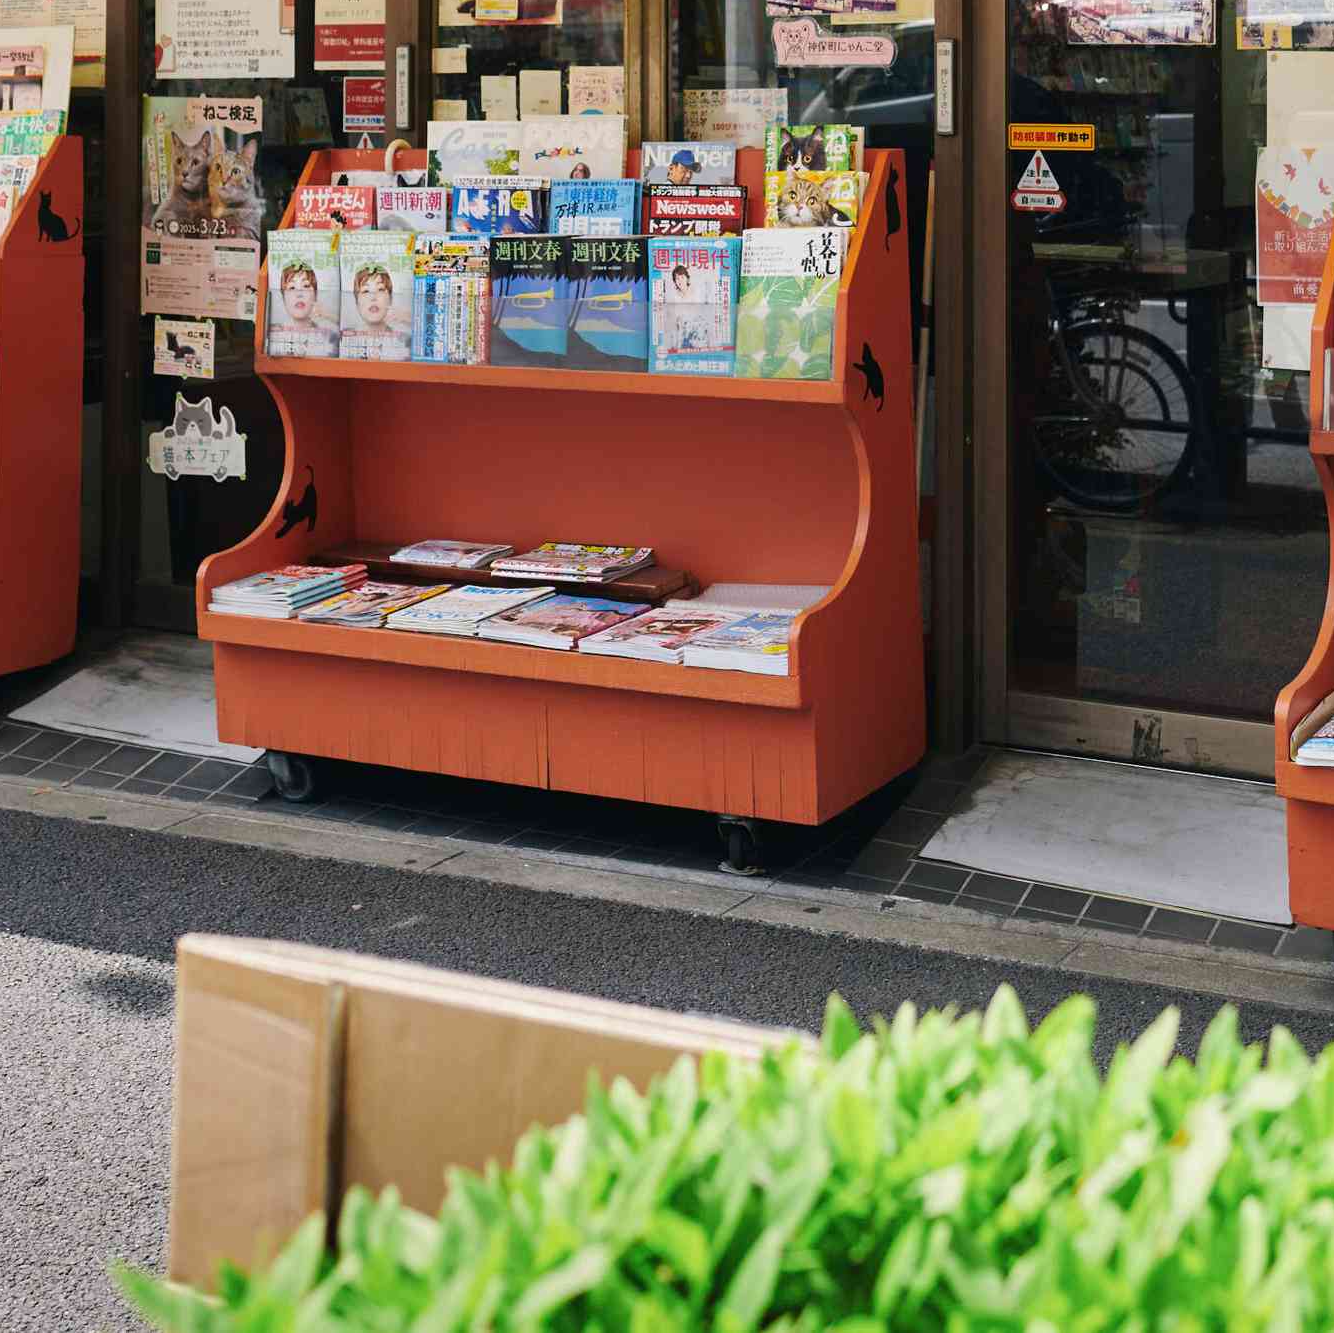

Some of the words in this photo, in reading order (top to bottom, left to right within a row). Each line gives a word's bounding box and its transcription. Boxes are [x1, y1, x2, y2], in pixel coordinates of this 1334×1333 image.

[807, 39, 884, 54] 神保町にゃんこ堂
[203, 104, 258, 125] ねこ検定
[1012, 132, 1089, 143] 防犯装置作動中
[1027, 169, 1050, 178] 注意
[300, 189, 365, 212] サザエさん
[379, 191, 443, 212] 週刊新潮
[655, 198, 737, 217] Newsweek
[494, 240, 562, 263] 週刊文春
[571, 241, 641, 263] 週刊文春
[653, 249, 730, 270] 週刊現代
